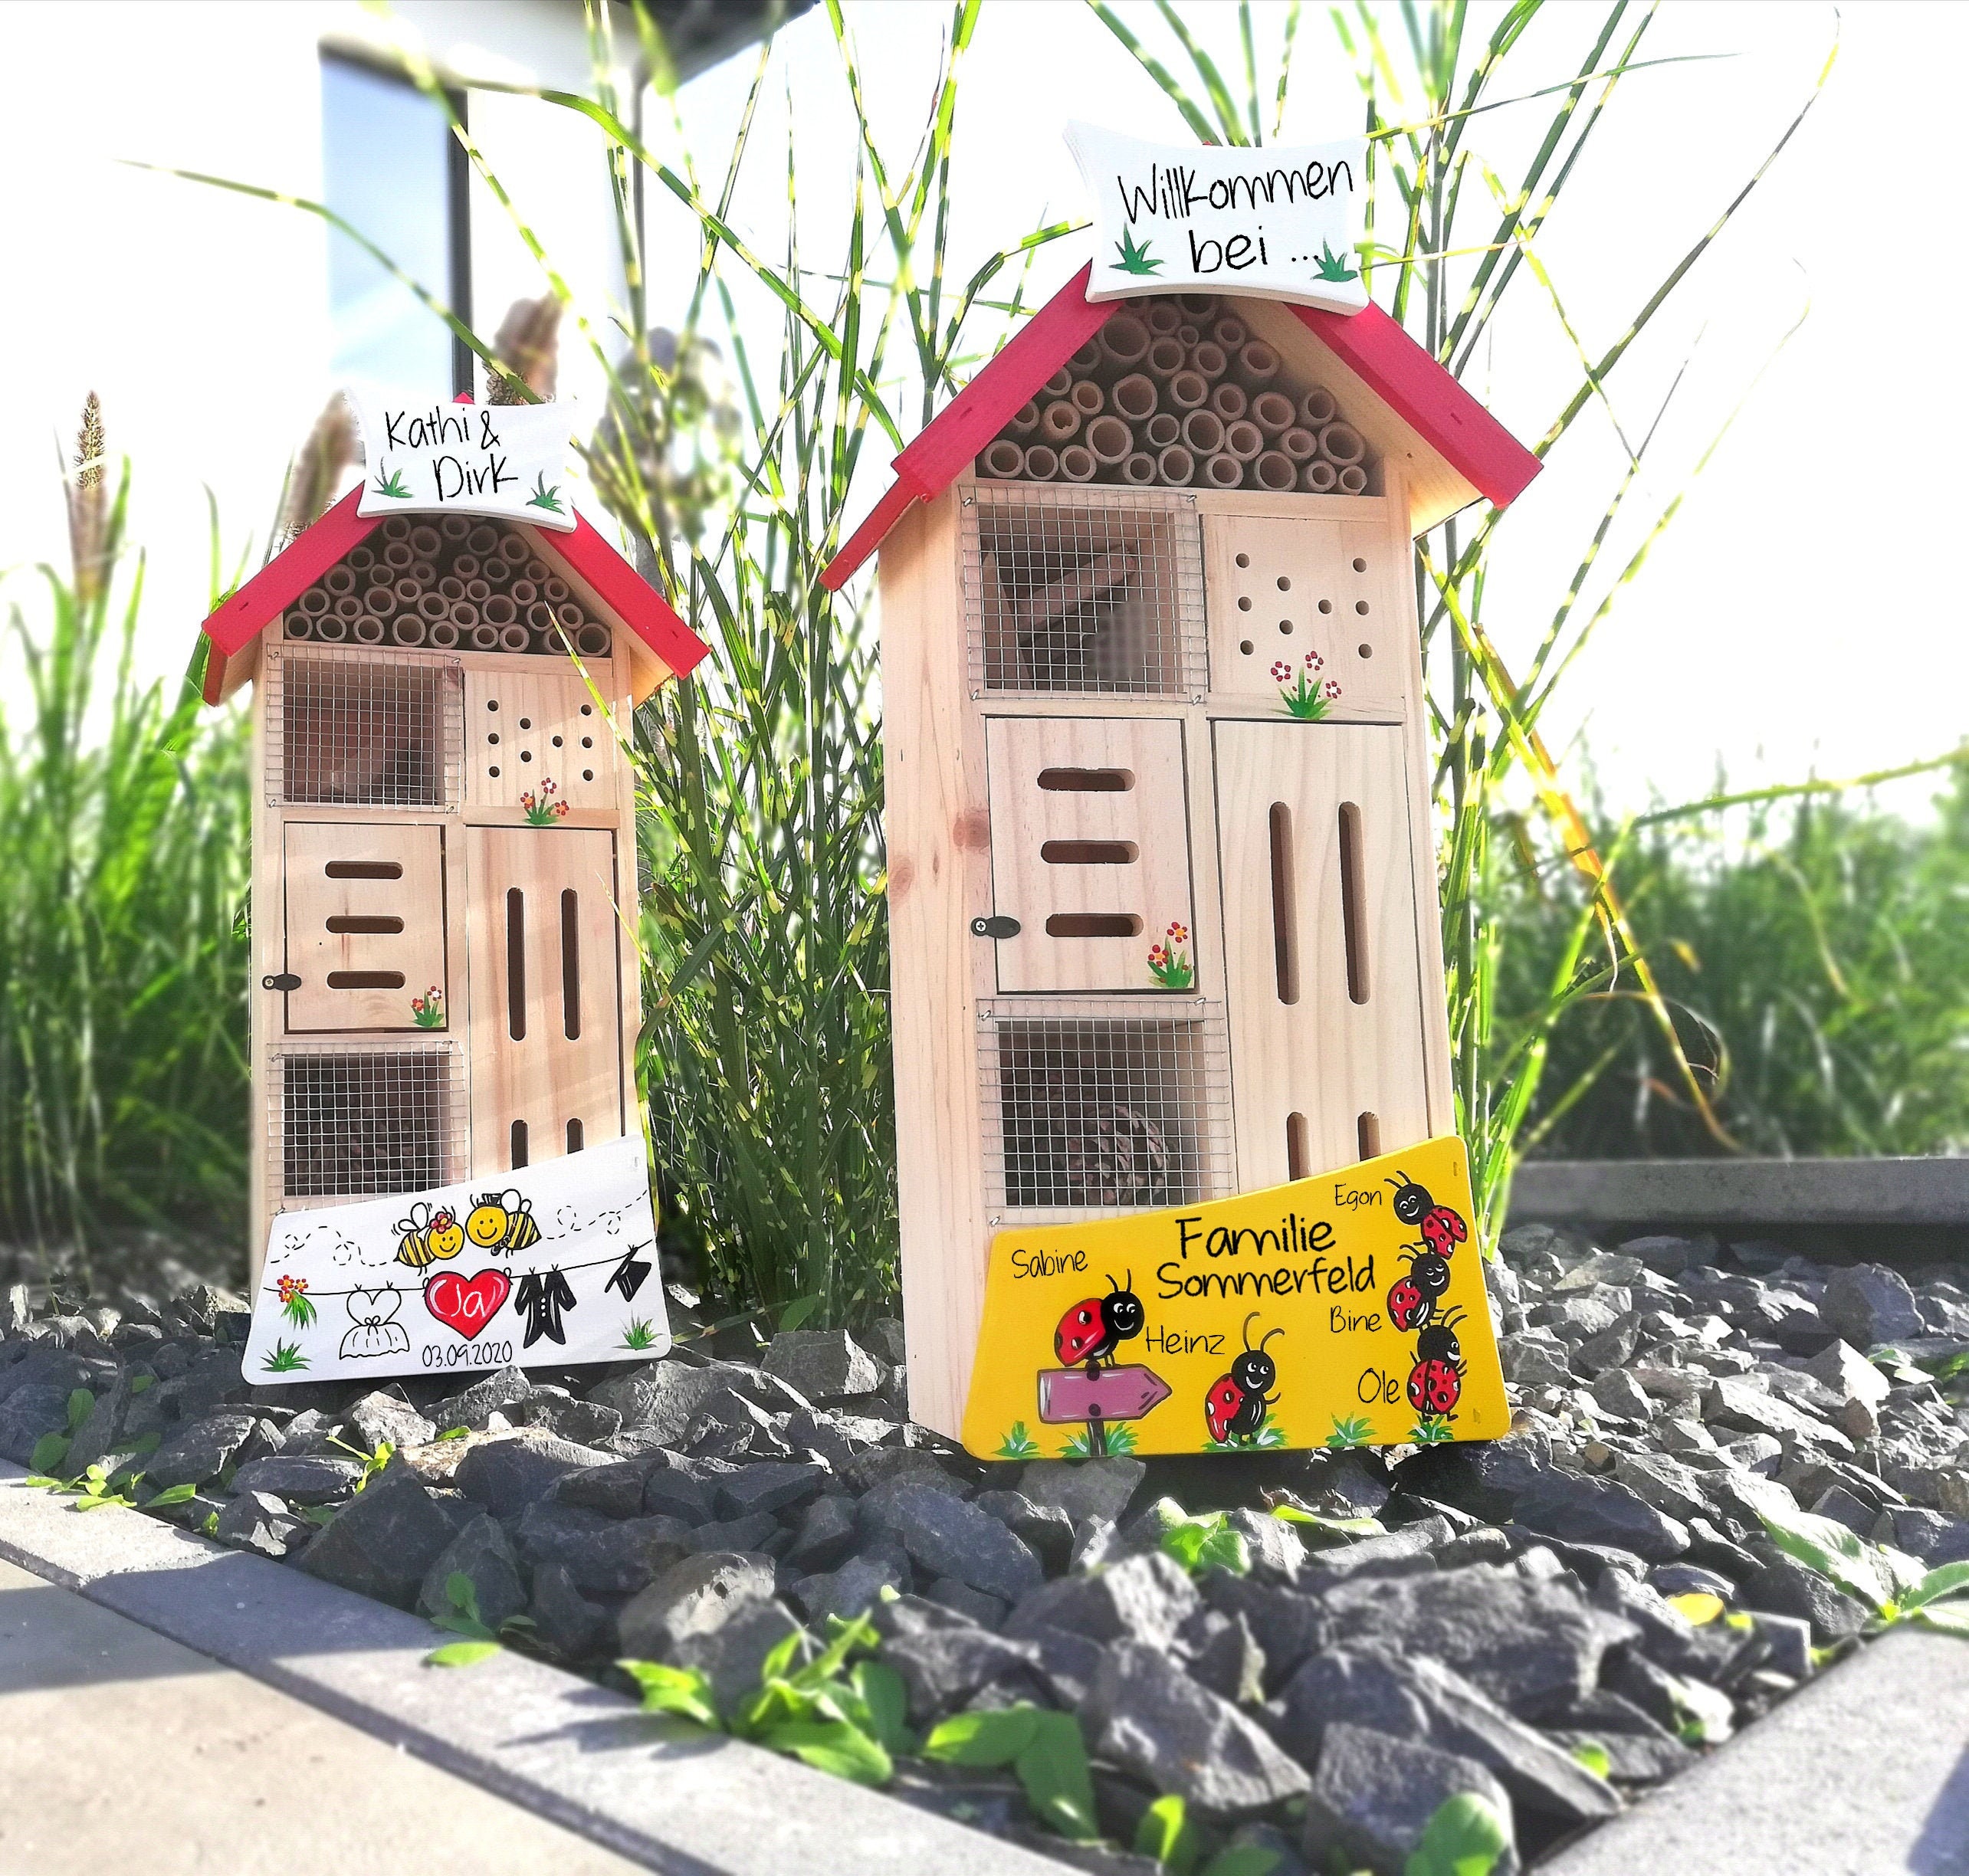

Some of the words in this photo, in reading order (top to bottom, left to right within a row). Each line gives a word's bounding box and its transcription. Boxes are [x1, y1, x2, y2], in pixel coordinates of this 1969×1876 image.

[1117, 161, 1354, 224] Willkommen
[1189, 226, 1268, 274] bei
[386, 406, 470, 451] Kathi
[481, 410, 500, 450] &
[432, 453, 519, 501] Dirk
[1334, 1184, 1382, 1212] Egon
[1175, 1213, 1335, 1258] Familie
[1011, 1248, 1088, 1279] Sabine
[1157, 1254, 1376, 1299] Sommerfeld
[450, 1283, 487, 1317] Ja
[1330, 1305, 1383, 1333] Bine
[422, 1340, 513, 1367] 03.09.2020
[1146, 1327, 1226, 1356] Heinz
[1357, 1368, 1401, 1405] Ole
